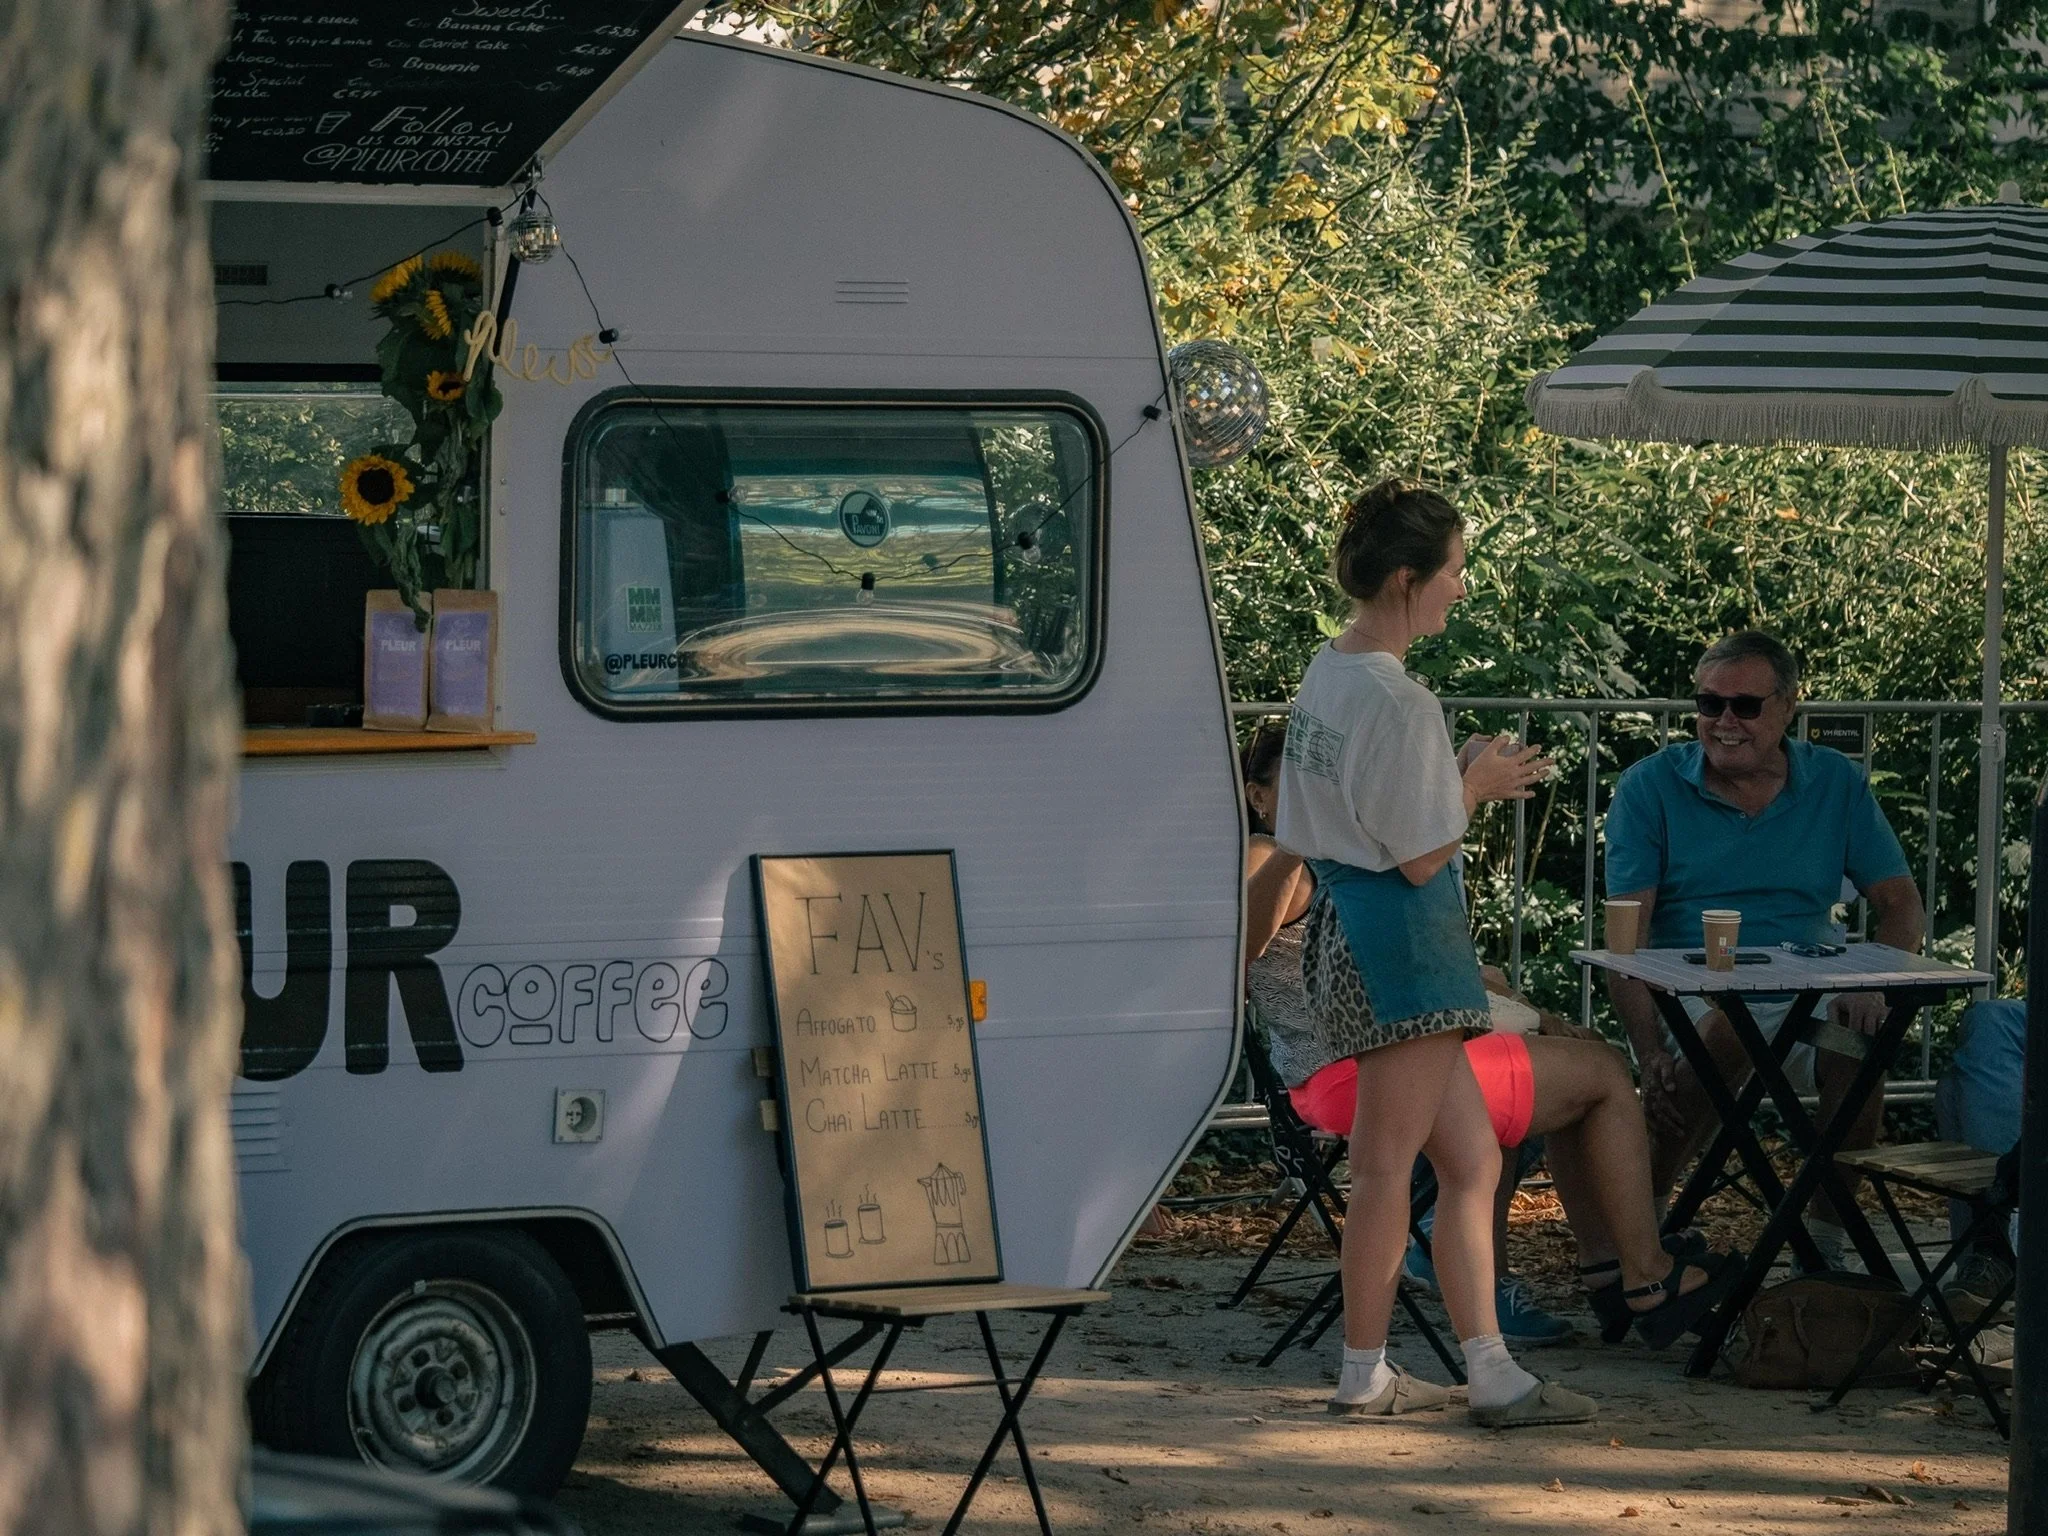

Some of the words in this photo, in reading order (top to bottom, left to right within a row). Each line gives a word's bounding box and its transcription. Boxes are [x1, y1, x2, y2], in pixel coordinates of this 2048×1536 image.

[437, 16, 502, 31] Banana
[506, 21, 545, 32] Cake
[418, 38, 469, 49] Carrot
[475, 40, 511, 50] Cake
[402, 56, 481, 73] Brownie
[370, 106, 513, 134] Follow
[393, 135, 424, 146] ON
